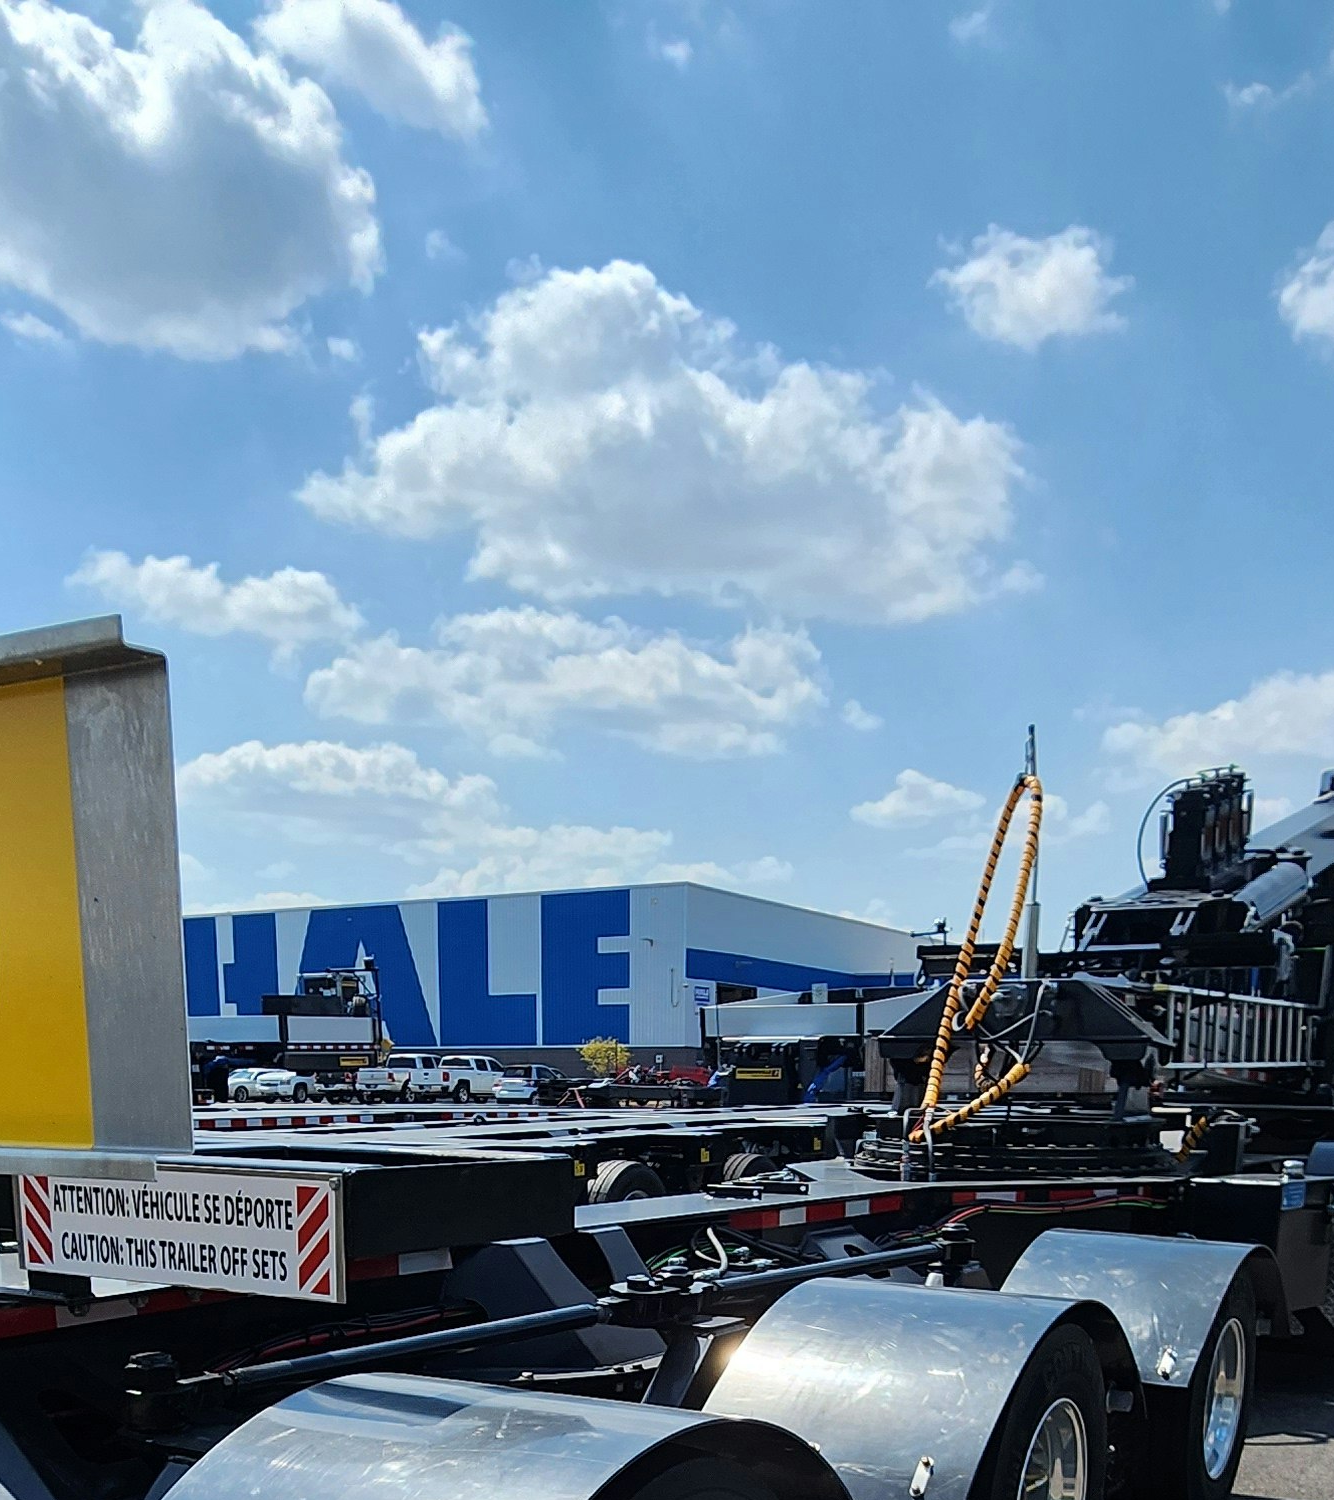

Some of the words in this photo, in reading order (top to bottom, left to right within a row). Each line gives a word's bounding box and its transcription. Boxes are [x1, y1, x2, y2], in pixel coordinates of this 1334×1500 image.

[183, 889, 630, 1046] HALE
[53, 1184, 130, 1218] ATTENTION:
[131, 1185, 200, 1223] VÉHICULE
[204, 1194, 221, 1225] SE
[225, 1190, 294, 1231] DÉPORTE
[61, 1232, 124, 1265] CAUTION:
[125, 1238, 157, 1269] THIS
[159, 1241, 217, 1274] TRAILER
[220, 1246, 249, 1277] OFF
[252, 1249, 288, 1282] SETS
